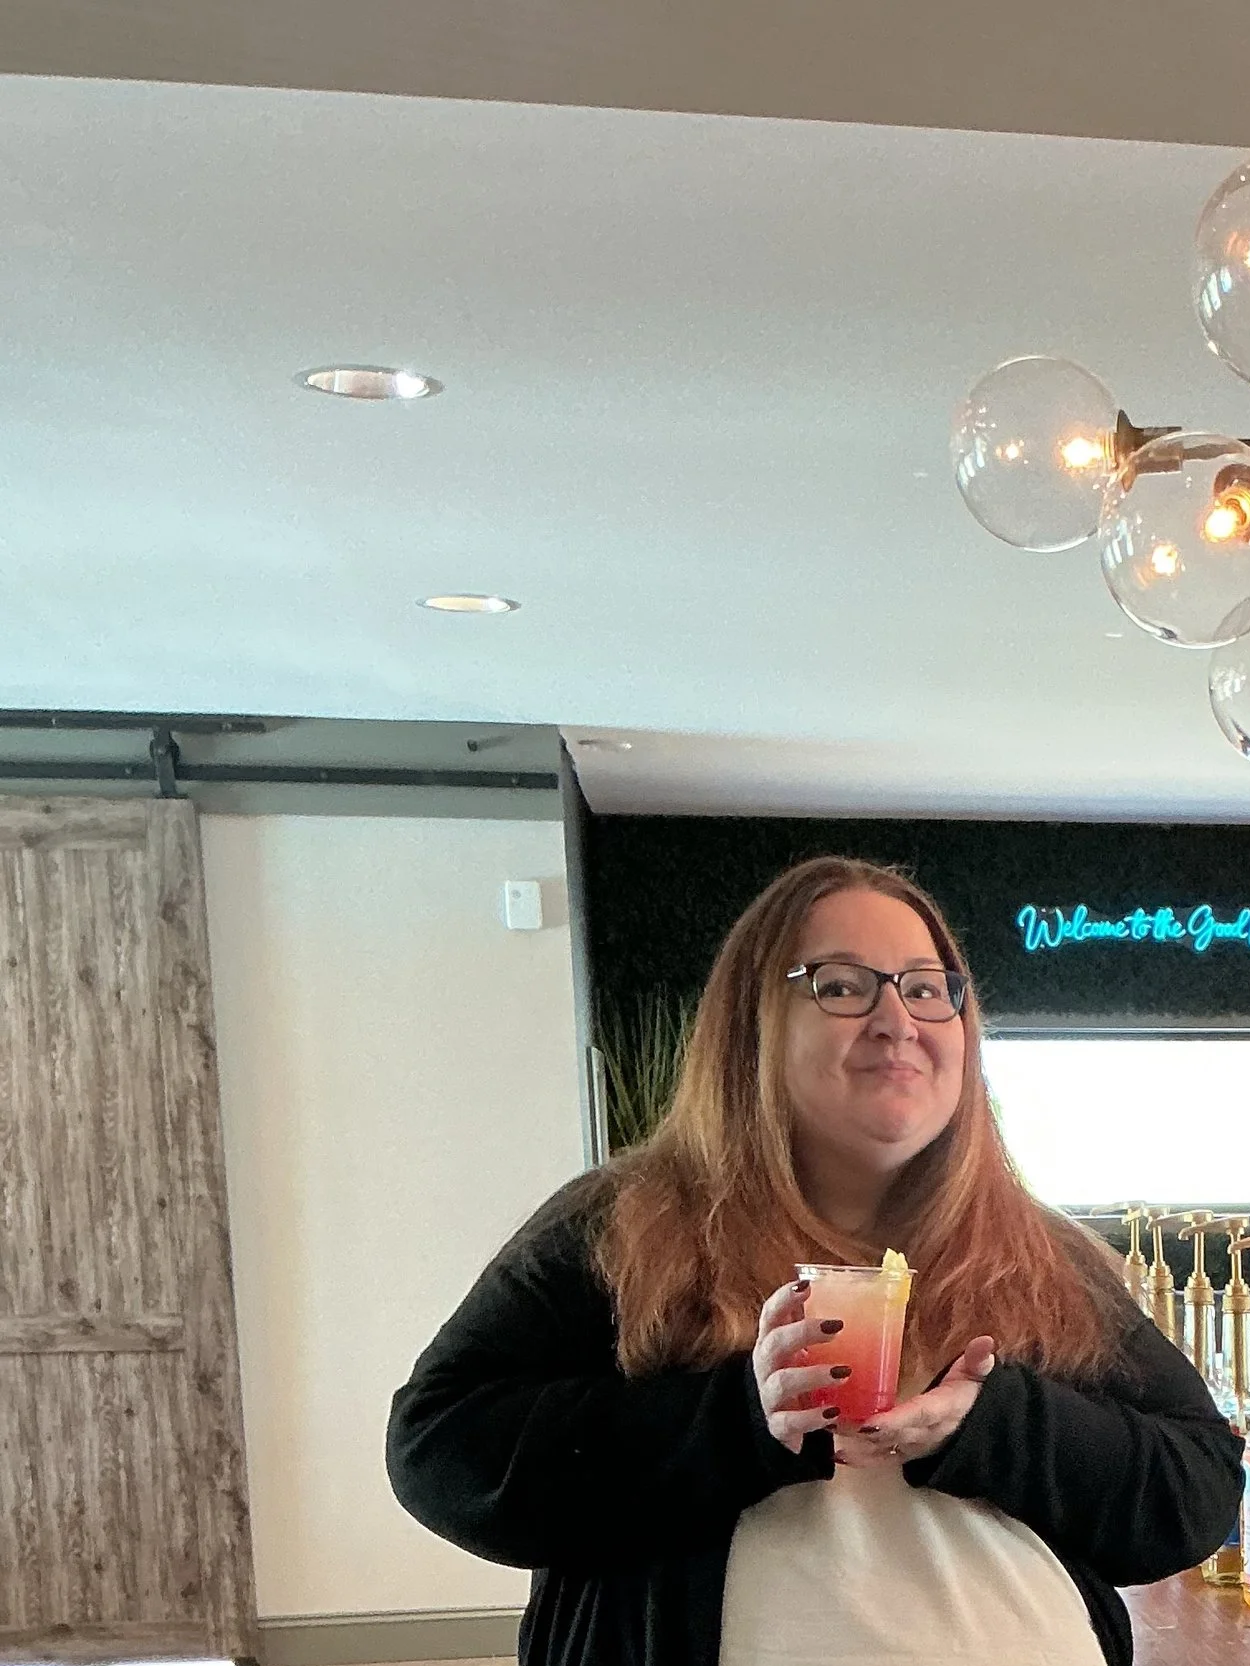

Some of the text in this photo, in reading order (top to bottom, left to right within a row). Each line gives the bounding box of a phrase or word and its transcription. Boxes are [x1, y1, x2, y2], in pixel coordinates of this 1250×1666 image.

[1017, 904, 1130, 951] Welcome
[1124, 907, 1151, 940] to
[1149, 907, 1187, 940] the
[1187, 903, 1249, 951] Good
